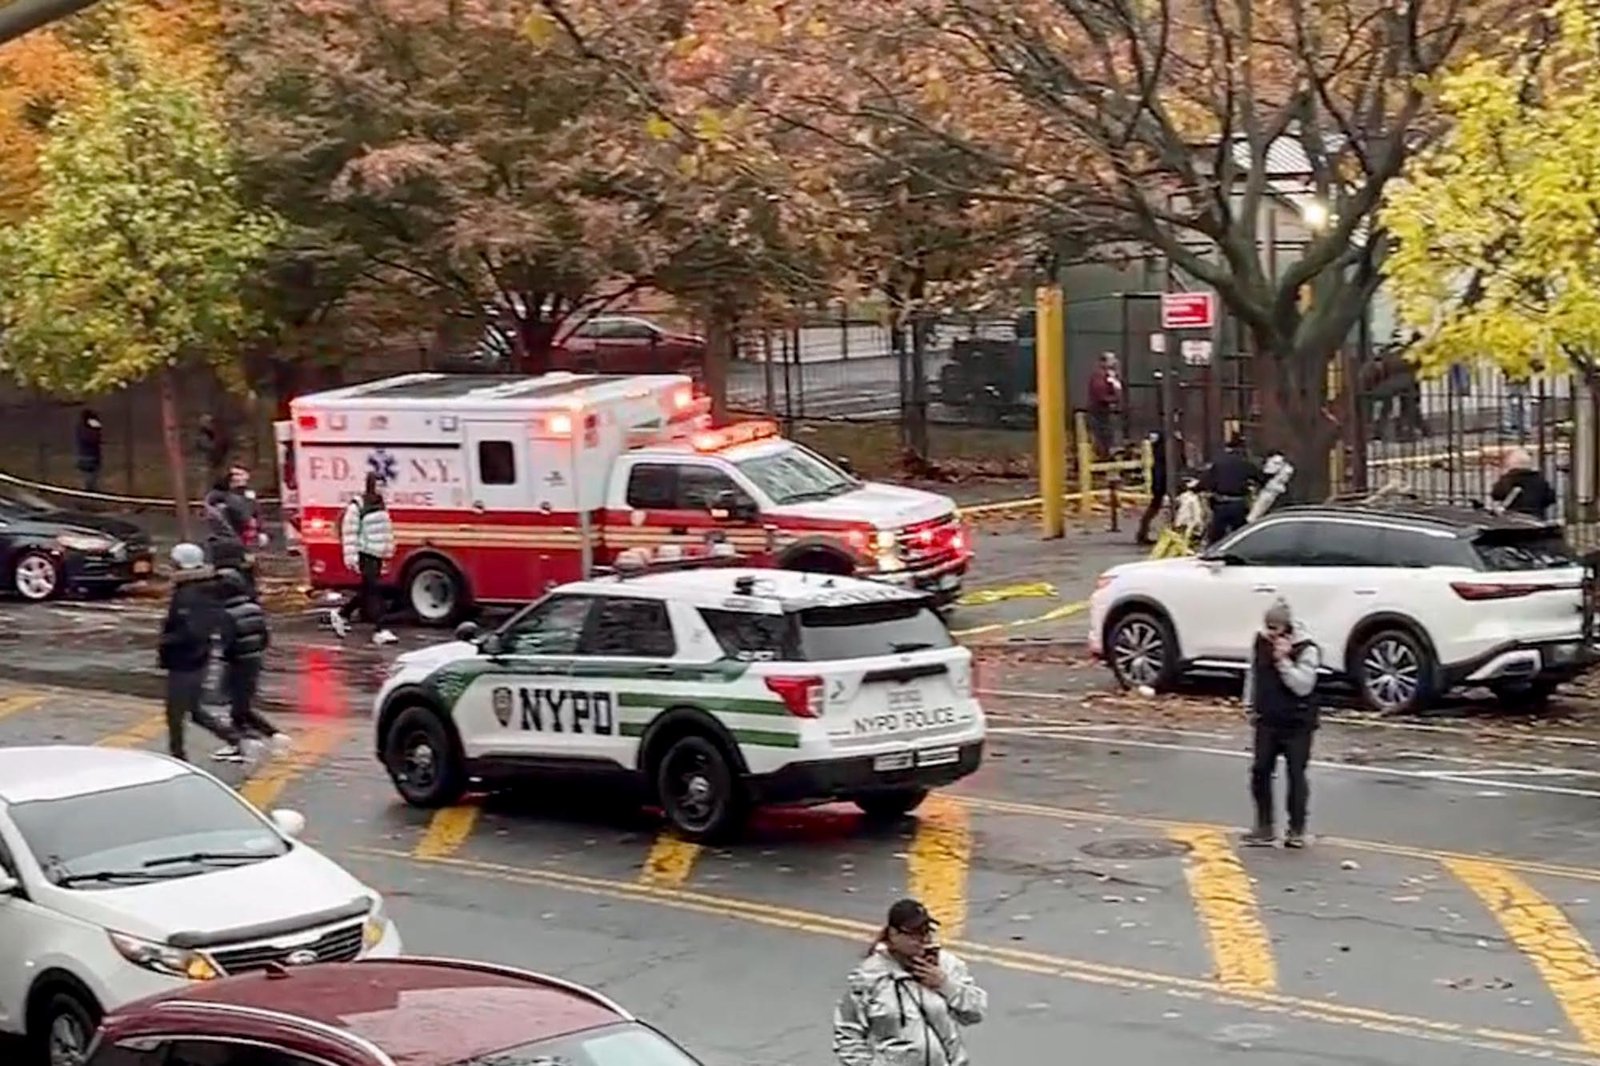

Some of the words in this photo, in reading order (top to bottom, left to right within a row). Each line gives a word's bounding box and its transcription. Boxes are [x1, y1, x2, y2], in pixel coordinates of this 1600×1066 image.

[410, 458, 460, 483] N.Y.
[519, 687, 612, 736] NYPD
[854, 714, 898, 734] NYPD
[904, 706, 955, 728] POLICE
